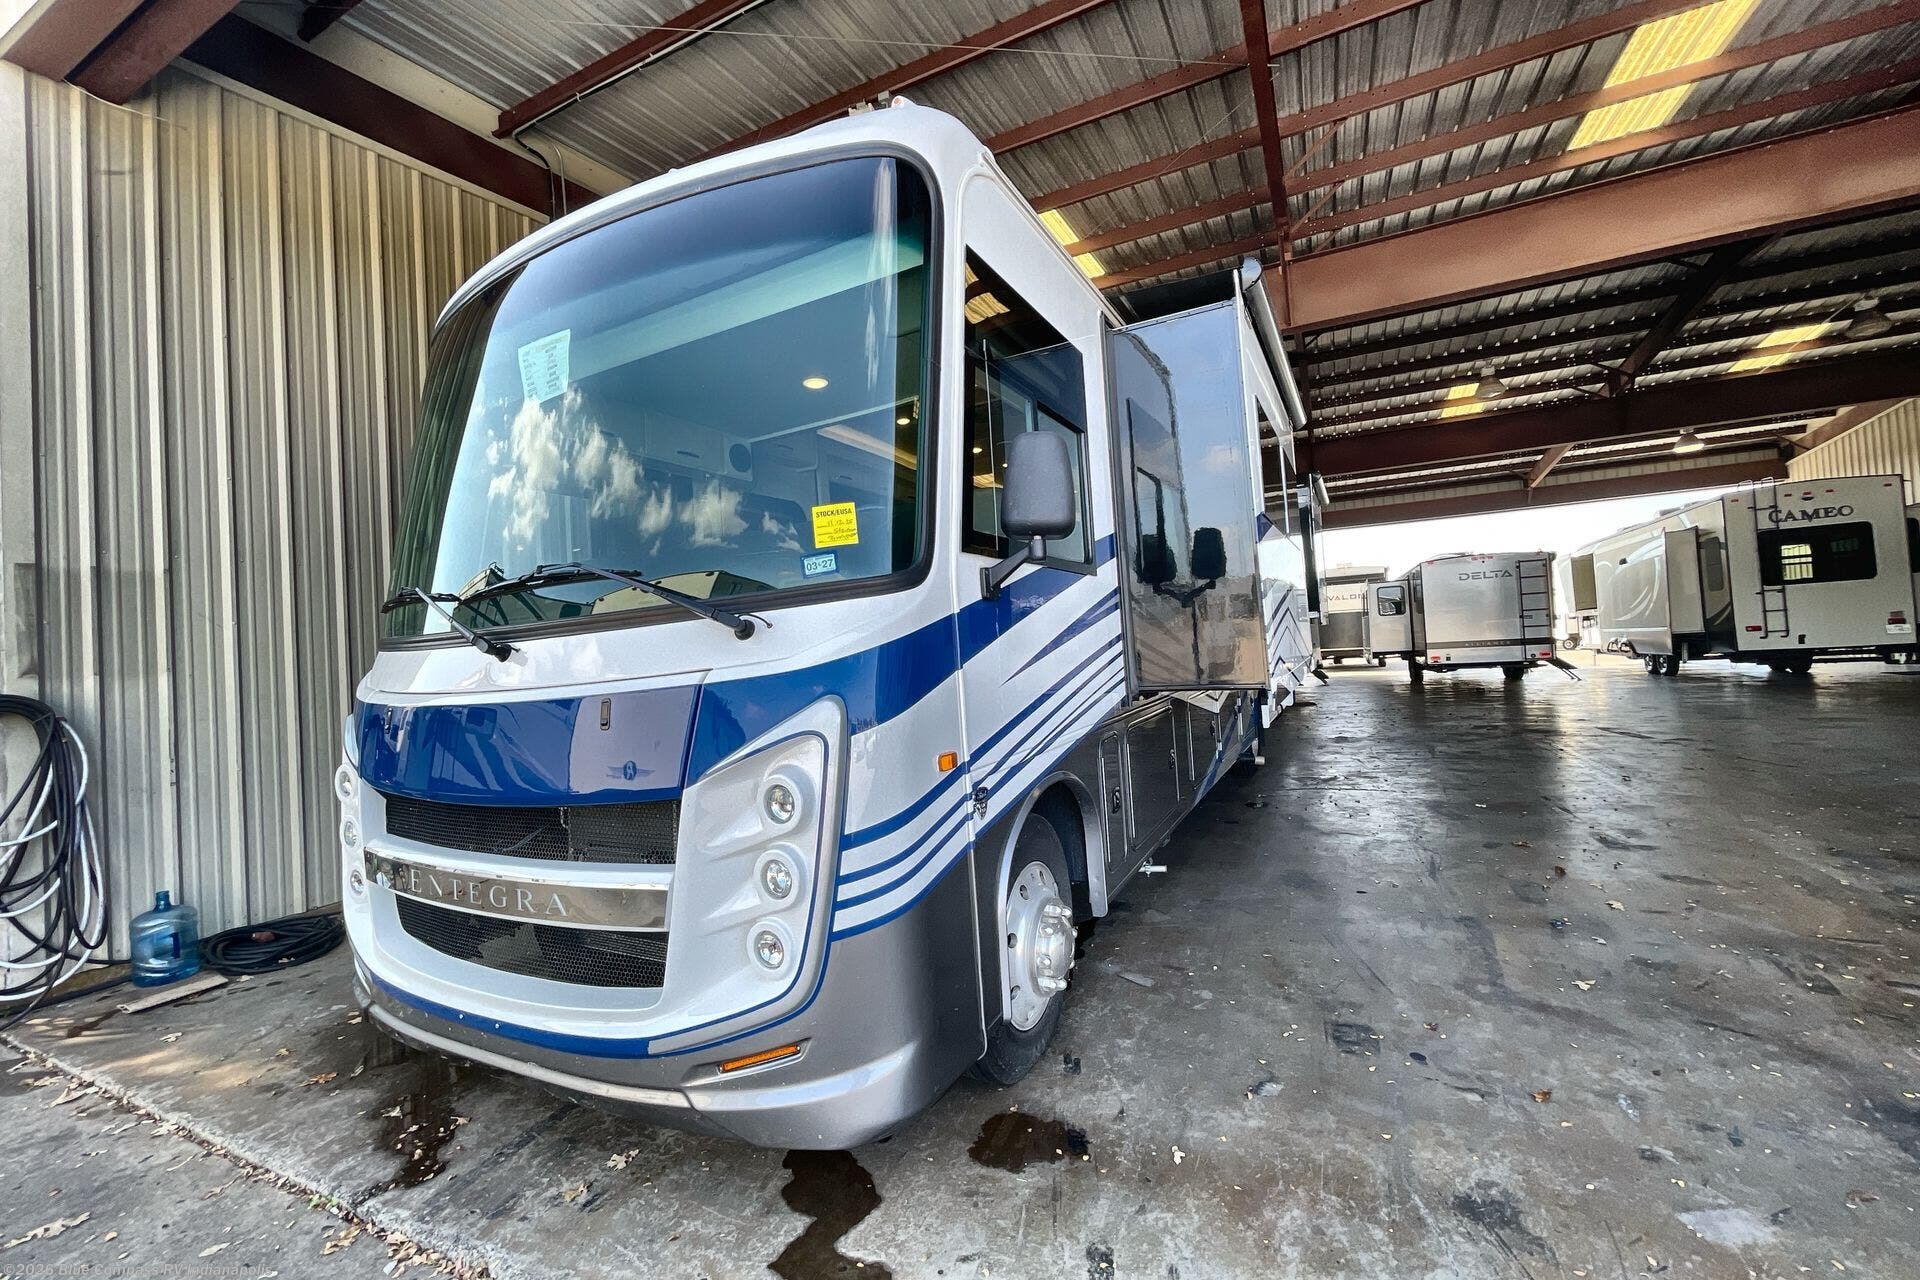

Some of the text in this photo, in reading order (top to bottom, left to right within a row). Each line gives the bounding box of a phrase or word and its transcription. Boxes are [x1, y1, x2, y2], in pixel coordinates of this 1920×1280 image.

[1768, 505, 1854, 523] CAMEO
[1458, 570, 1513, 580] DELTA
[410, 868, 568, 917] ENTEGRA
